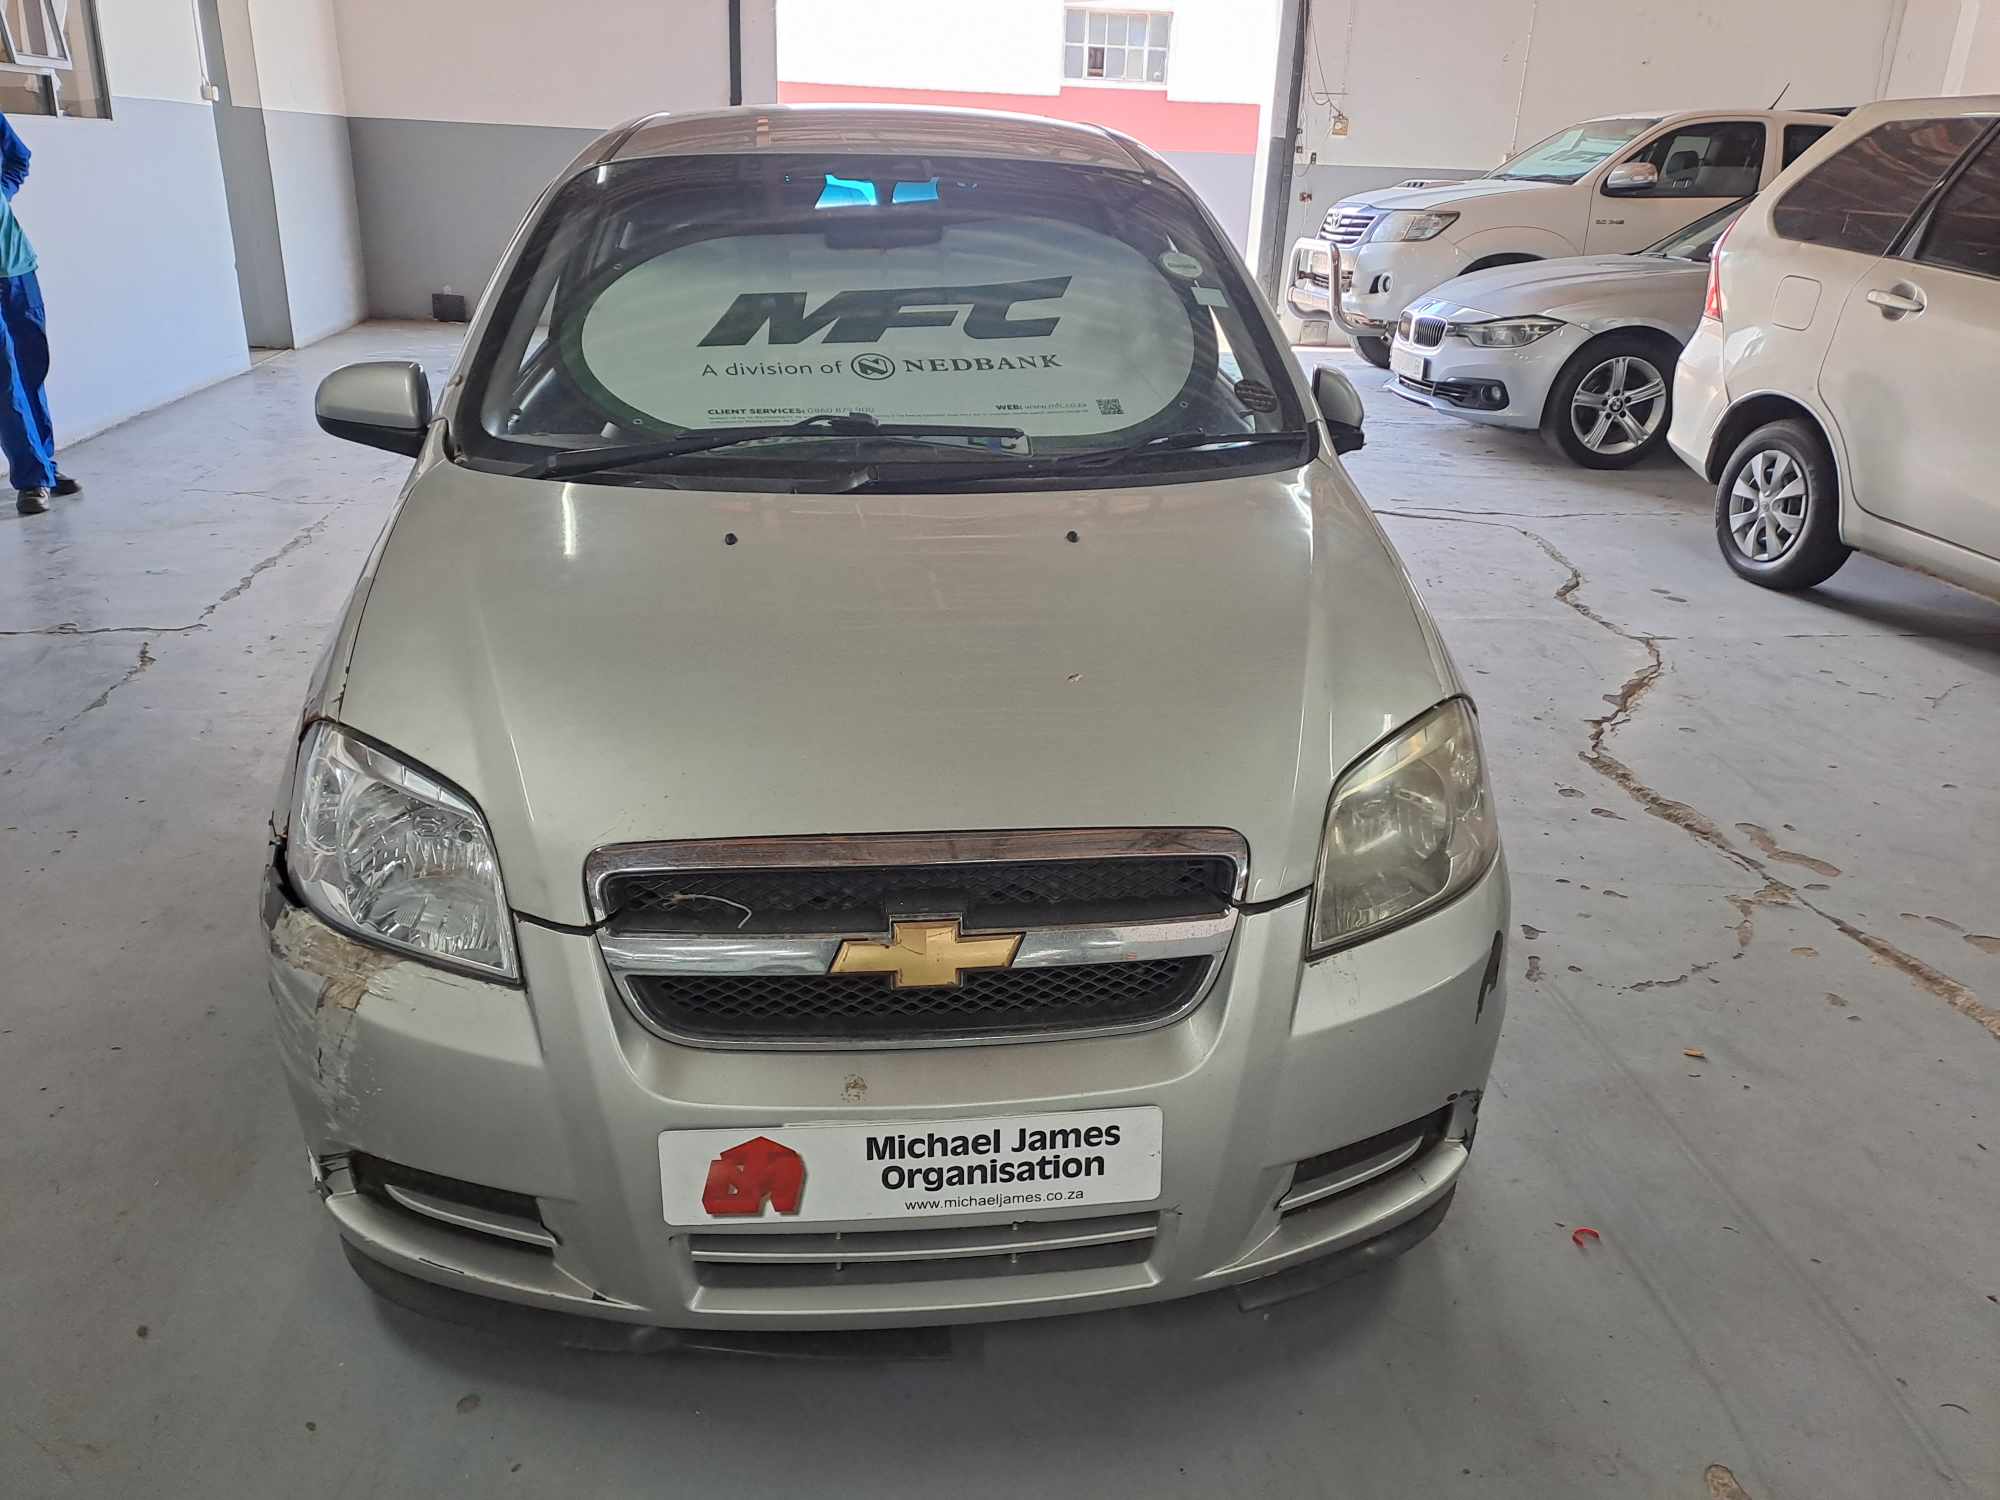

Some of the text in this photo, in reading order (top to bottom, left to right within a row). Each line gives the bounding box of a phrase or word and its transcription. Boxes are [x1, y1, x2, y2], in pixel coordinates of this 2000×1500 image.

[696, 276, 1072, 347] MFC
[702, 364, 718, 377] A
[726, 360, 812, 376] division
[820, 360, 843, 375] of
[904, 353, 1064, 373] NEDBANK
[750, 407, 806, 415] SERVICES:
[866, 1124, 1121, 1161] Michael James
[881, 1155, 1105, 1192] Organisation
[905, 1189, 1084, 1210] www.michaeljames.co.za
